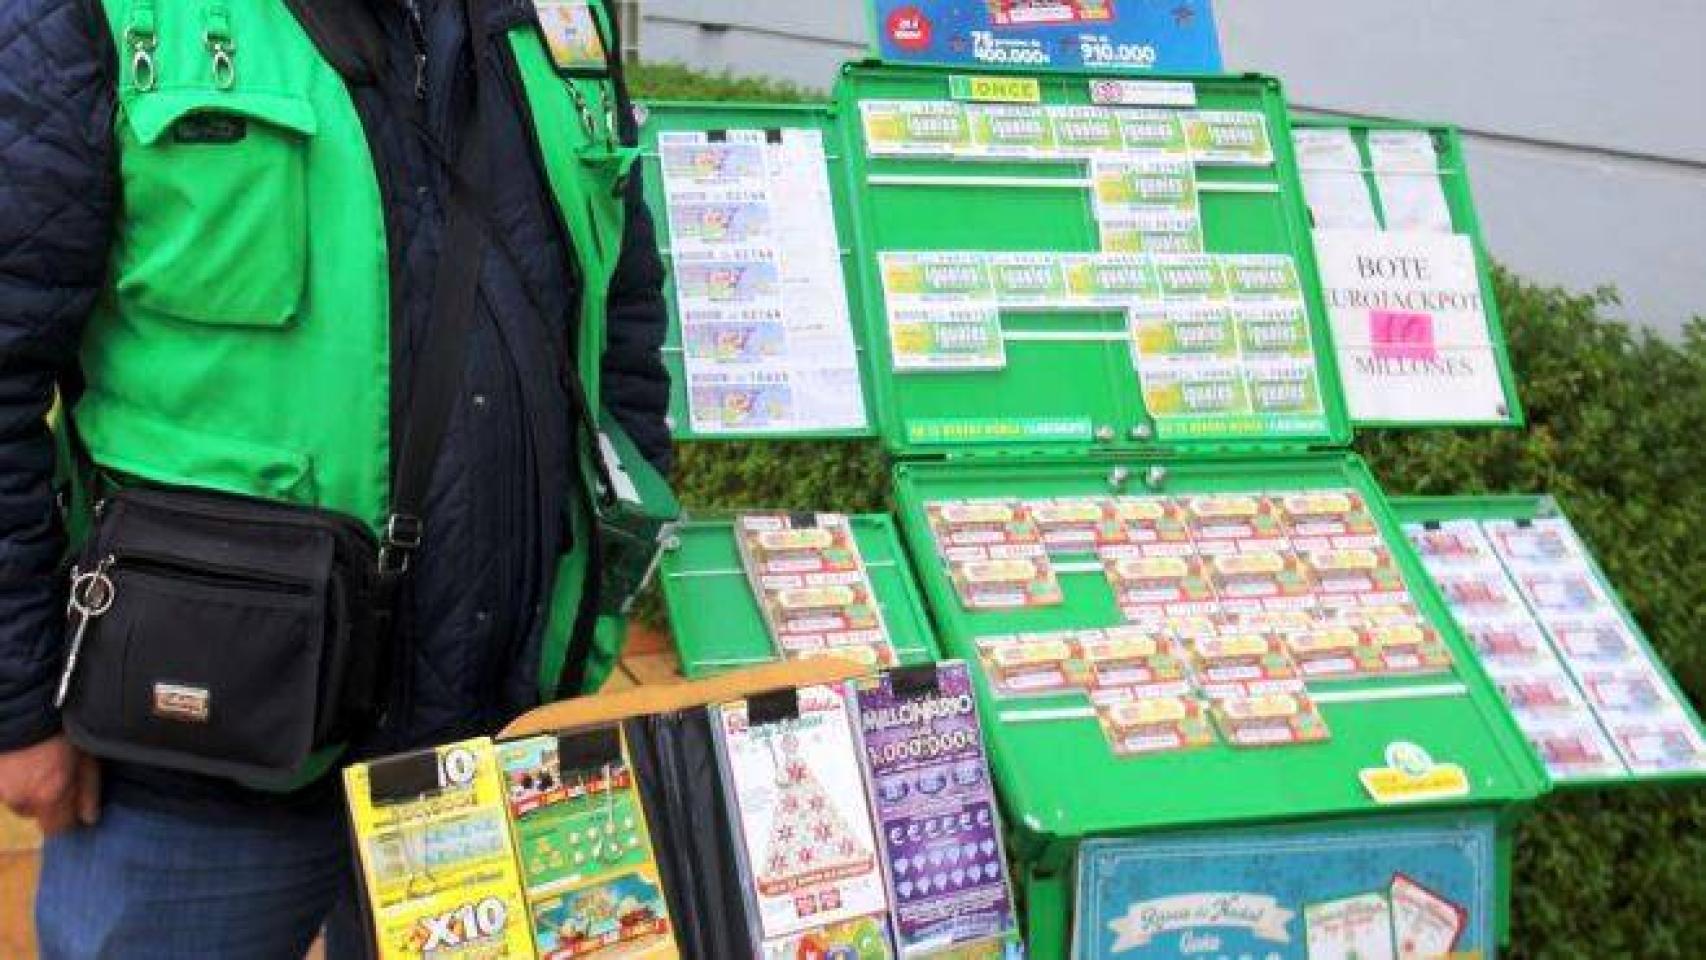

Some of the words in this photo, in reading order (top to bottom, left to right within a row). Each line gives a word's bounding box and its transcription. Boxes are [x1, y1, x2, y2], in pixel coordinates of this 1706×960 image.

[975, 81, 1036, 99] ONCE
[1356, 256, 1431, 281] BOTE
[1354, 354, 1474, 377] MILLONES
[422, 895, 508, 952] X10
